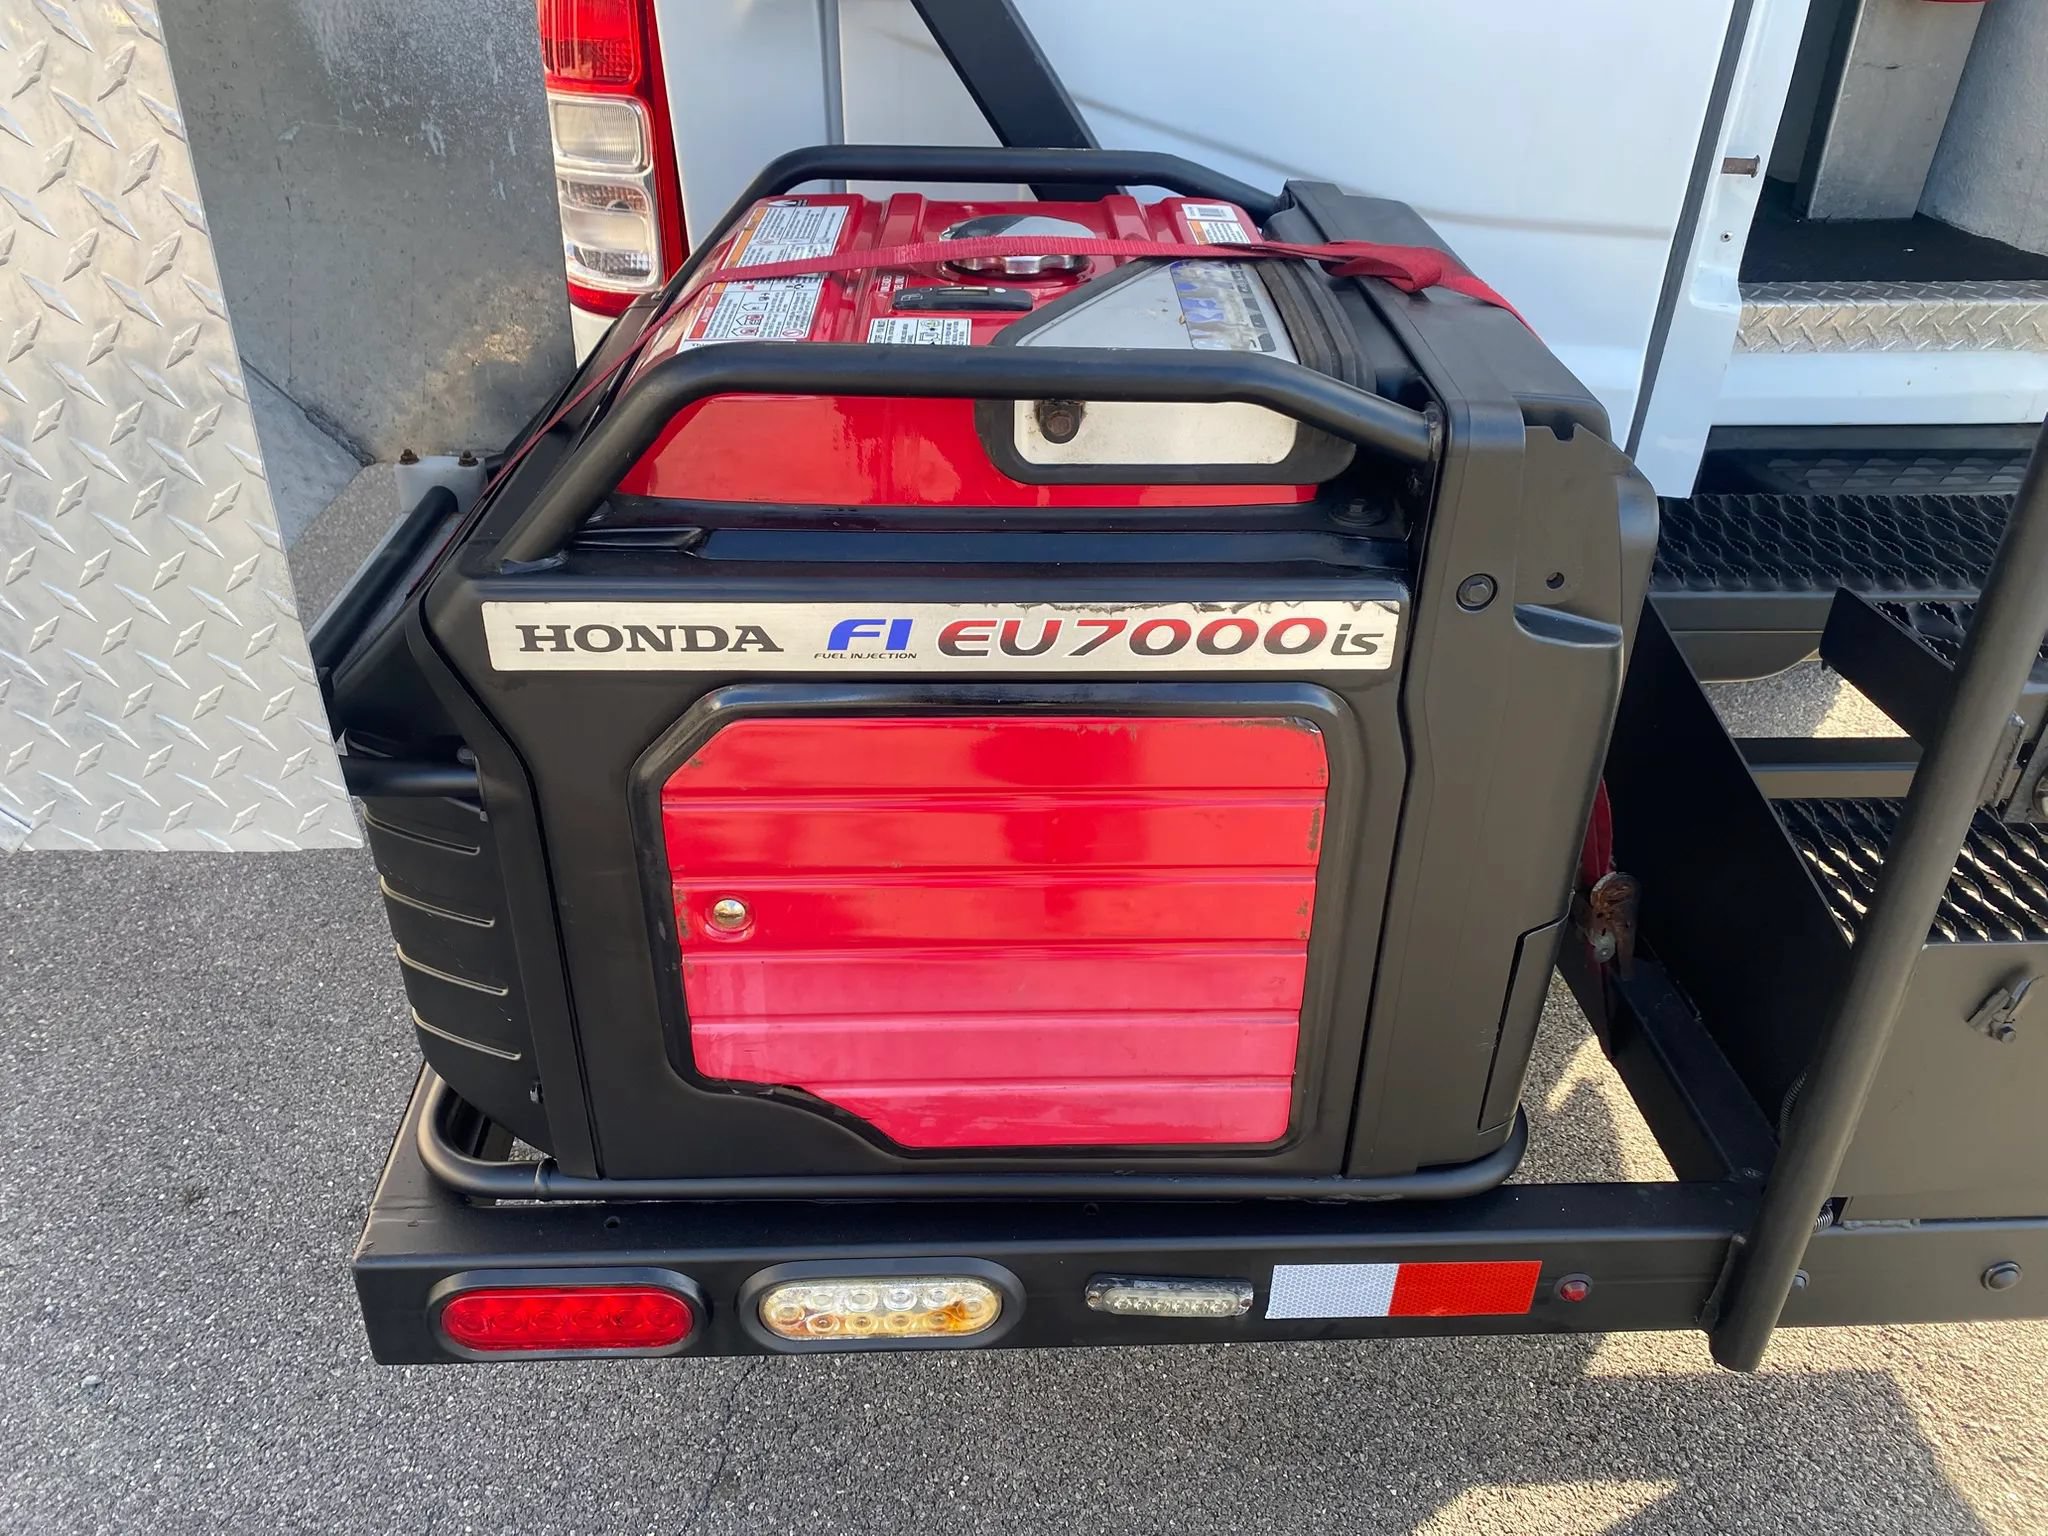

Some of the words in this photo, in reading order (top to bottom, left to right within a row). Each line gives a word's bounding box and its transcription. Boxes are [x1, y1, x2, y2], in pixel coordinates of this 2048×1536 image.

[515, 624, 785, 653] HONDA
[827, 618, 914, 651] FI
[813, 652, 847, 660] FUEL
[850, 652, 918, 660] INJECTION
